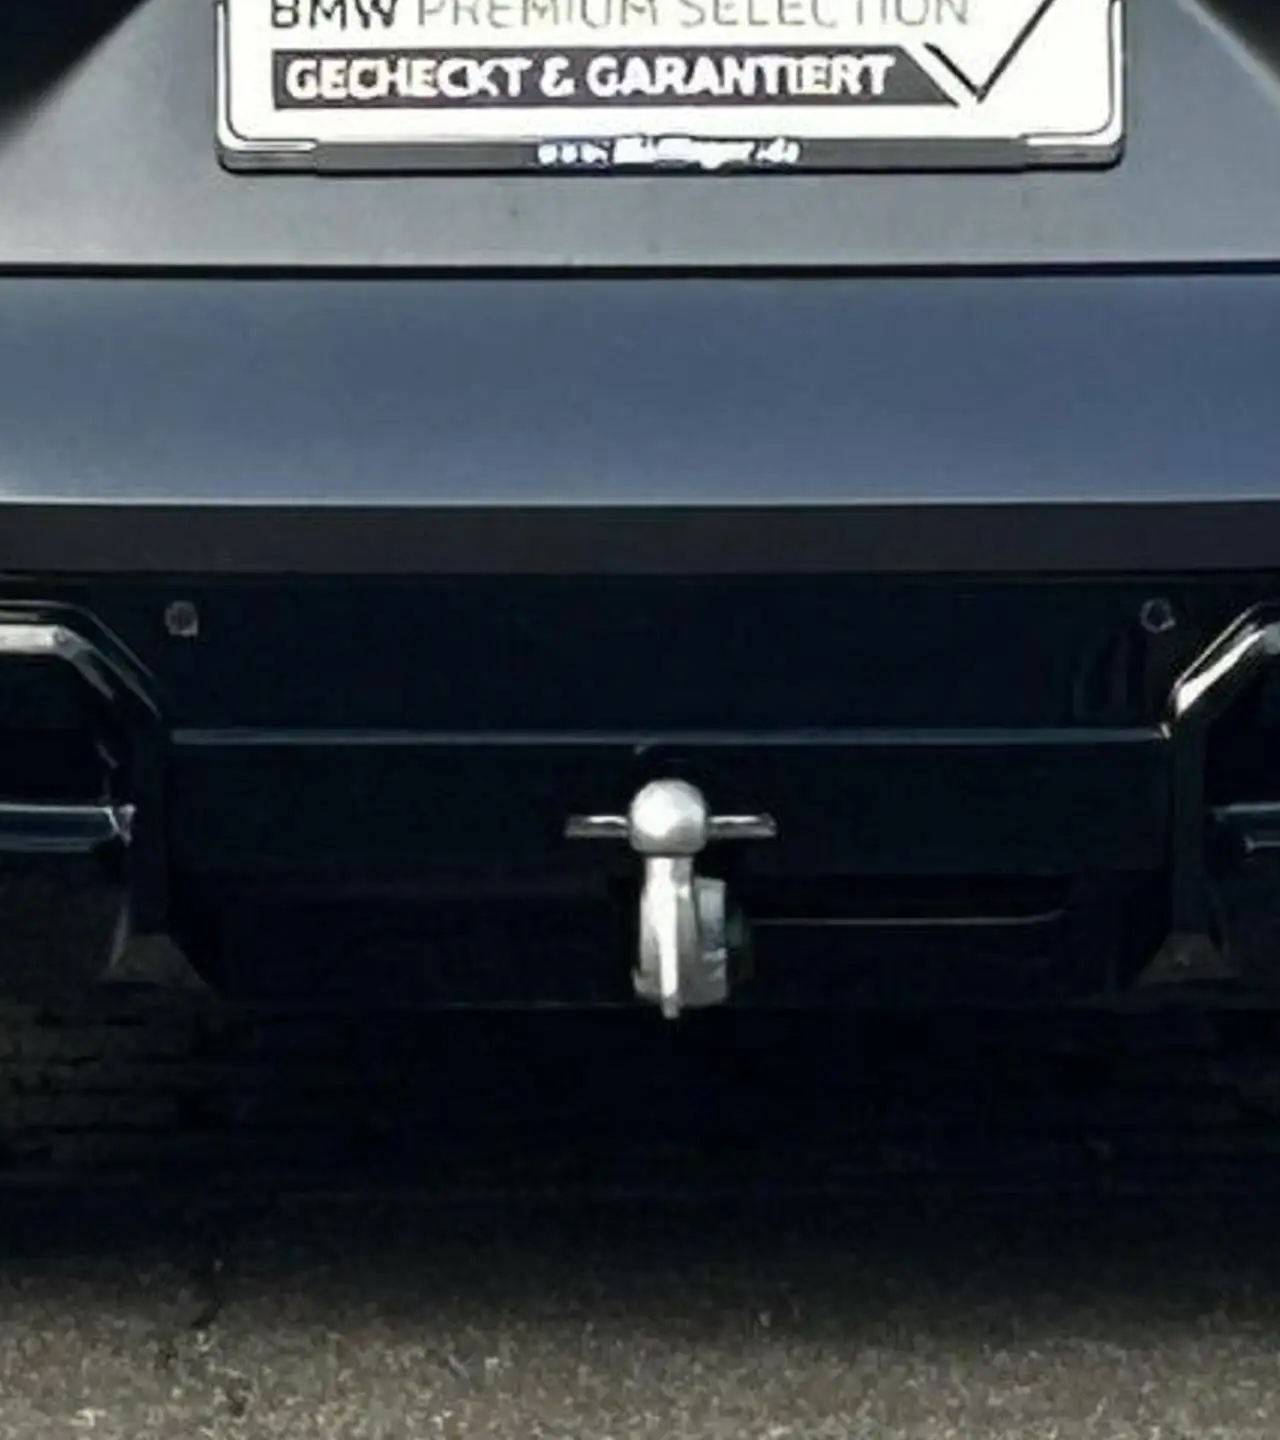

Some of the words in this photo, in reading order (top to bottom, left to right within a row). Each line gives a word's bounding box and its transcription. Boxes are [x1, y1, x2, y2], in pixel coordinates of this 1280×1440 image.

[285, 55, 532, 100] GECHECKT
[539, 56, 575, 99] &
[586, 54, 896, 98] GARANTIERT
